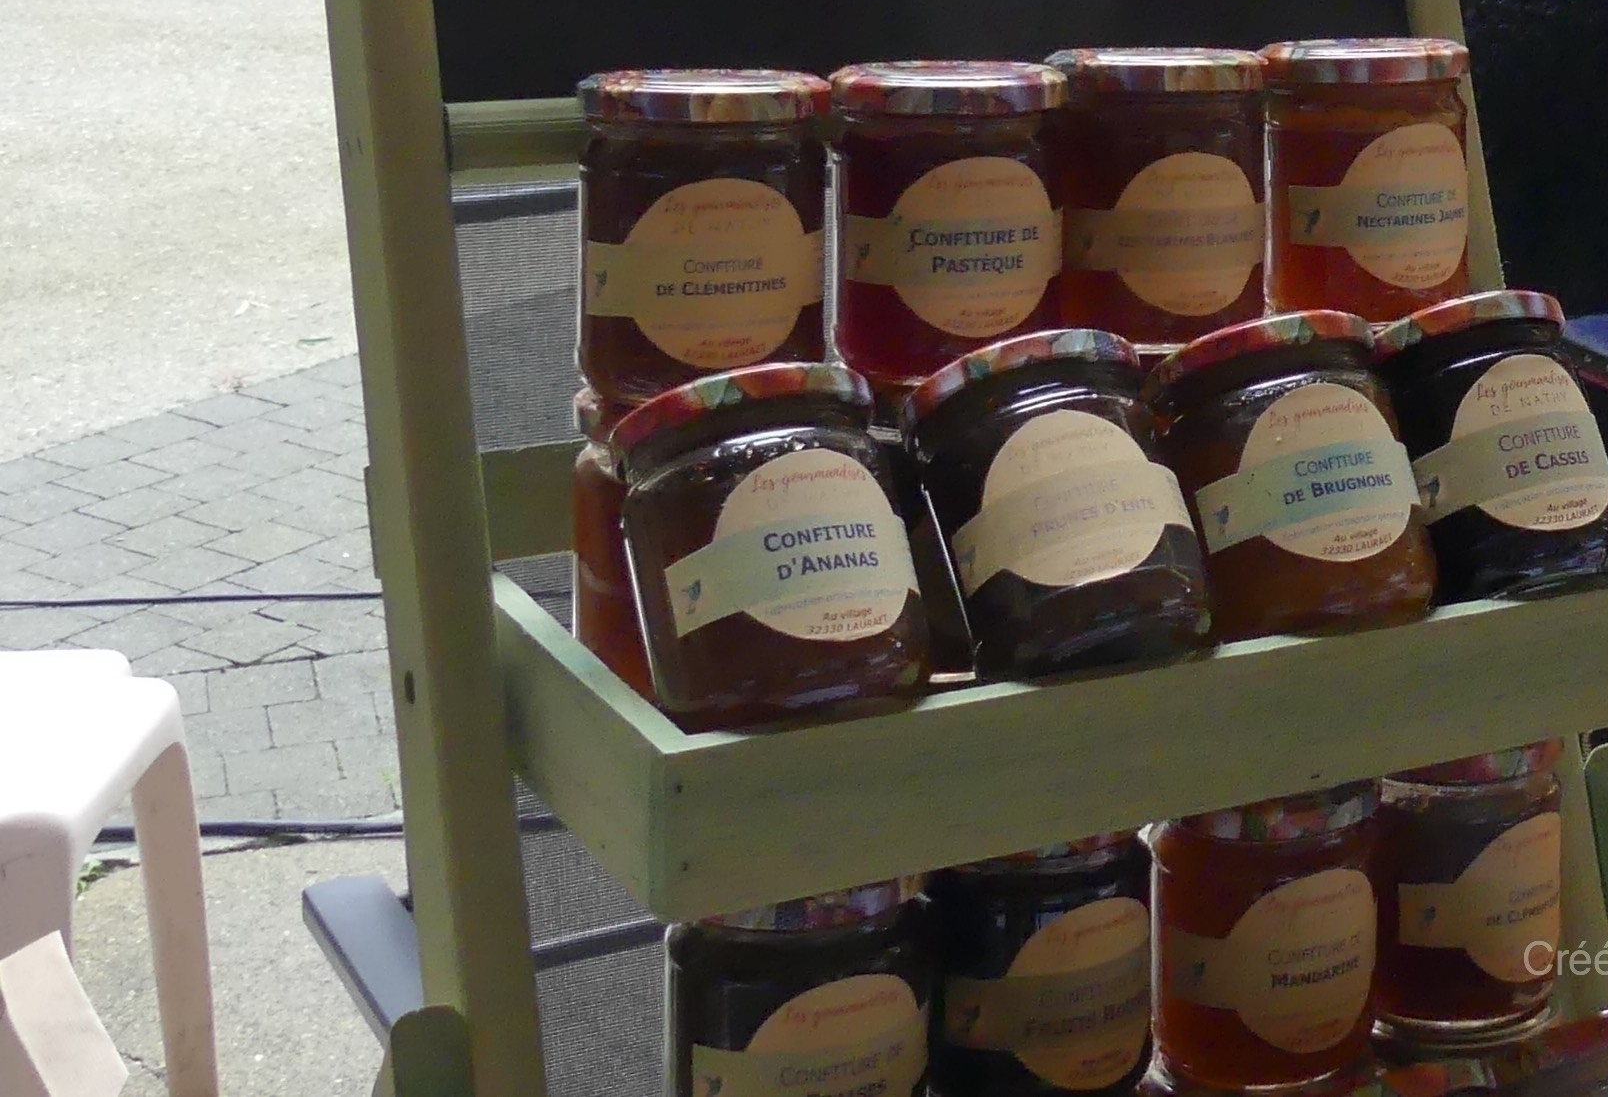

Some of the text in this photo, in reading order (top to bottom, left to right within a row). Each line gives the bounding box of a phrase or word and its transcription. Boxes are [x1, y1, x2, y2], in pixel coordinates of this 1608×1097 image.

[1506, 450, 1590, 479] DE CASSIS
[1283, 472, 1393, 505] DE BRUGNONS
[763, 523, 877, 553] CONFITURE
[776, 551, 880, 581] D'ANANAS
